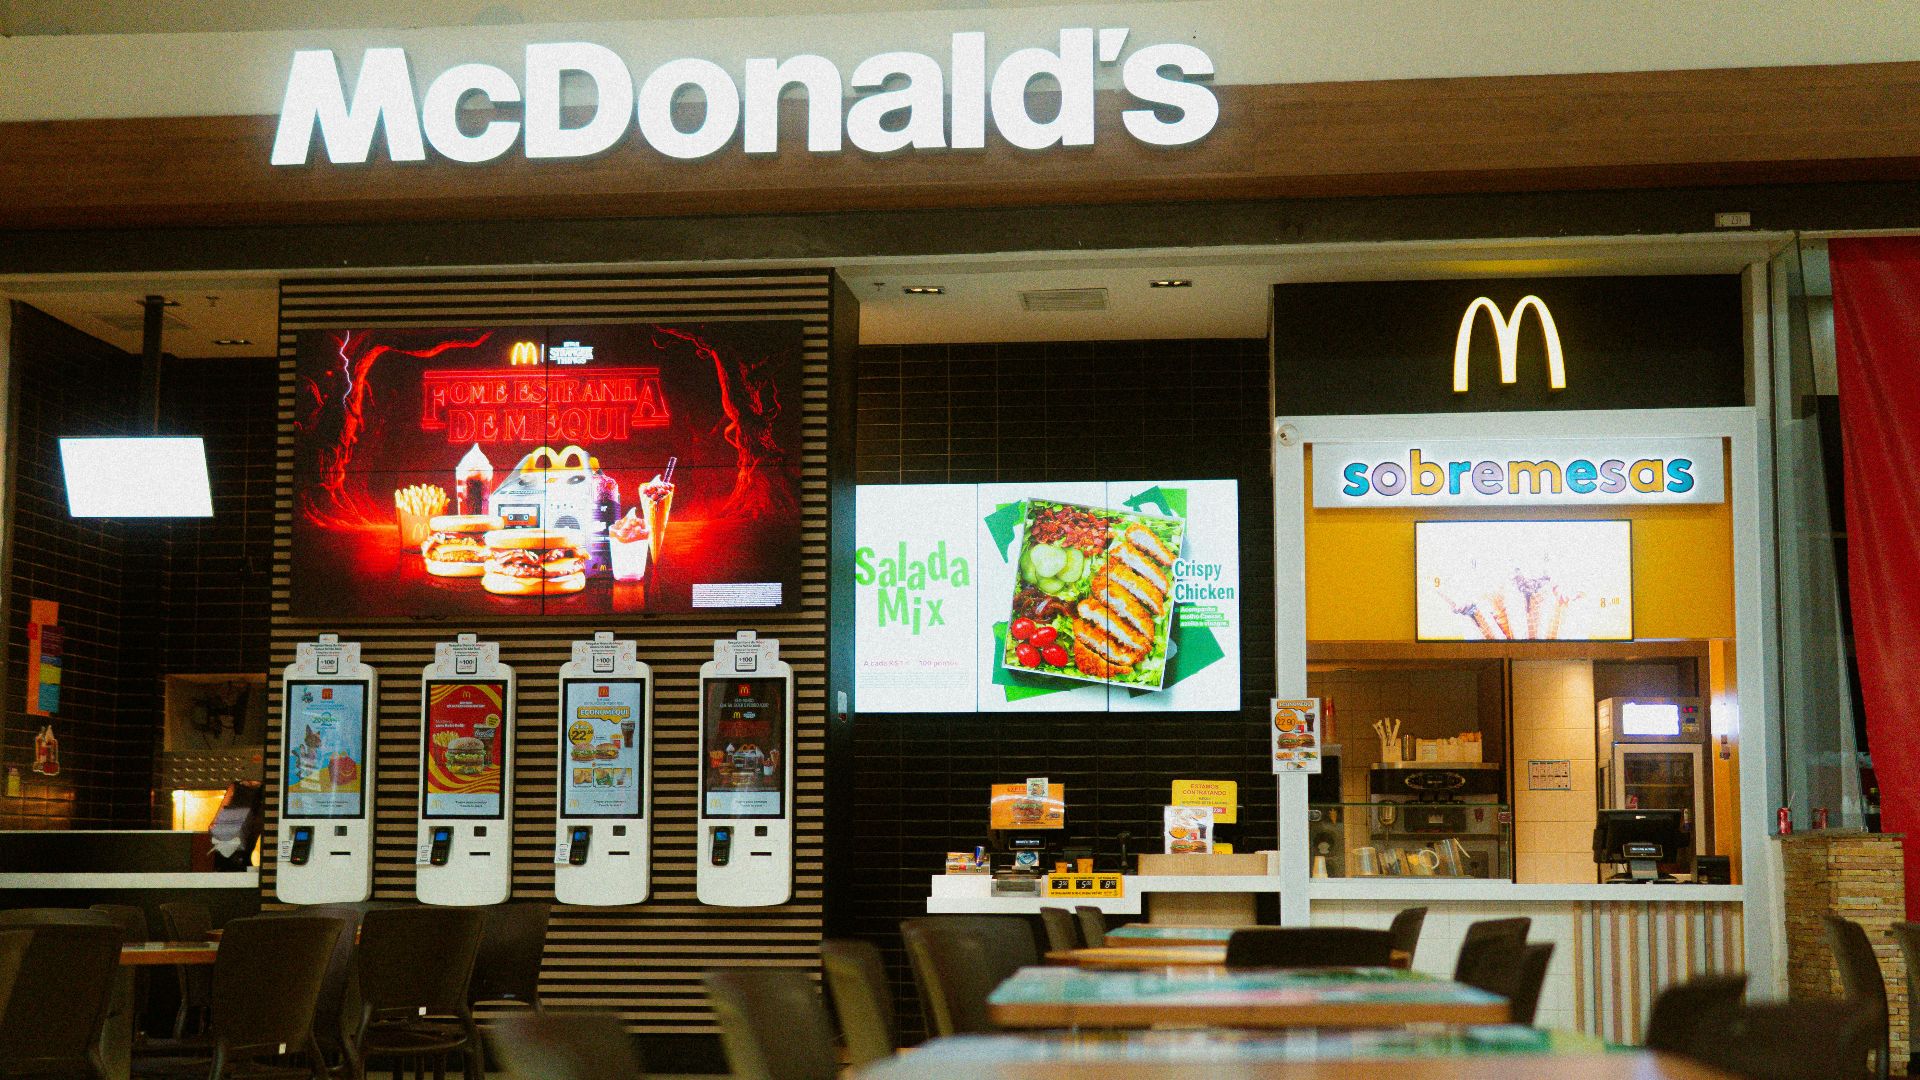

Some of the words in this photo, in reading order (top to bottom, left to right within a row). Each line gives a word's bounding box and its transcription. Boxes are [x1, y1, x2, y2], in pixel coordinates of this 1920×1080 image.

[271, 28, 1220, 166] McDonald's
[424, 379, 508, 421] FOME
[513, 377, 669, 418] ESTRANHA
[449, 408, 498, 441] DE
[1342, 448, 1695, 496] sobremesas
[855, 540, 970, 591] Salada
[1175, 560, 1222, 581] Crispy
[877, 586, 946, 636] Mix
[1175, 583, 1235, 600] Chicken
